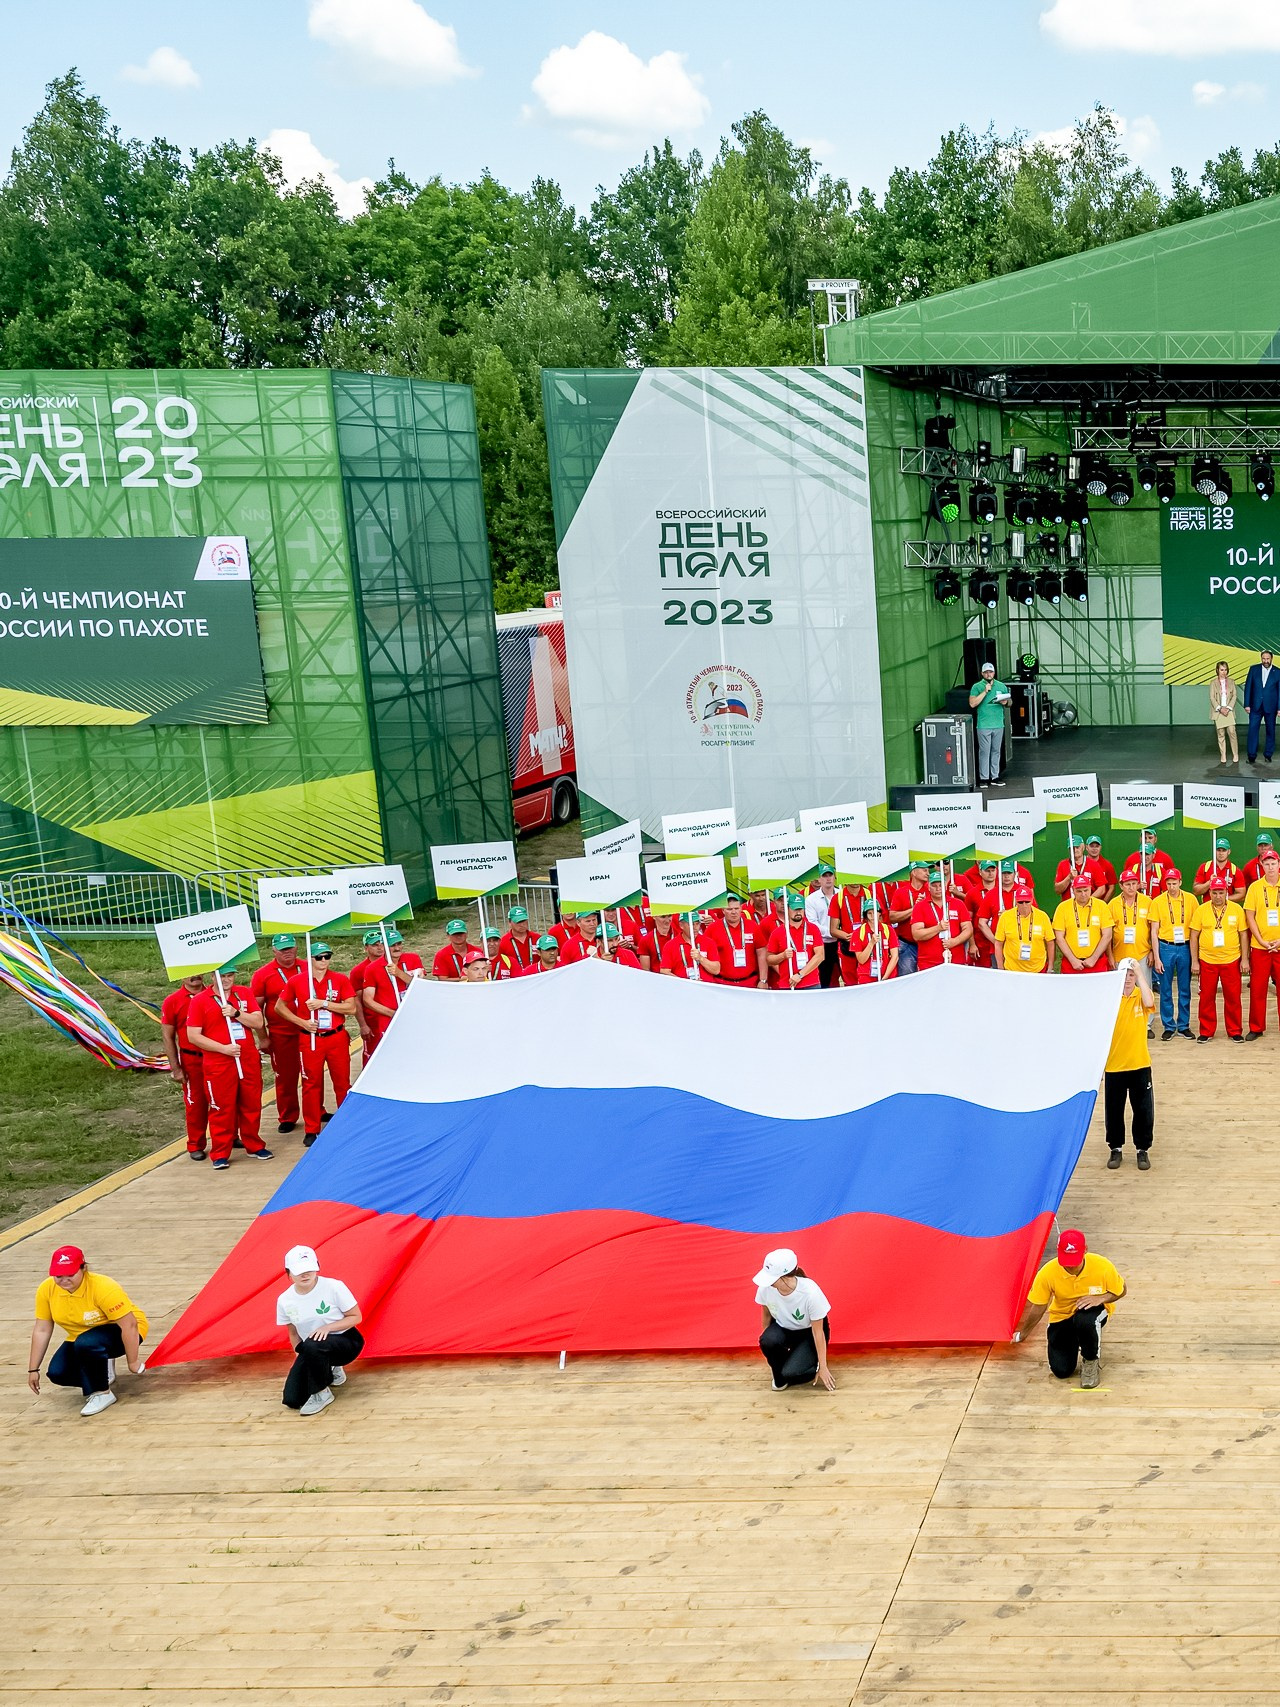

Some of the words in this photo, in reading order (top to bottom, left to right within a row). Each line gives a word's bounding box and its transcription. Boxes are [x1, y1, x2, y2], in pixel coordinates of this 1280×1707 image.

[0, 394, 79, 409] СИЙСКИЙ
[111, 396, 198, 439] 20
[118, 446, 203, 488] 23
[656, 507, 766, 520] ВСЕРОССИЙСКИЙ
[1170, 511, 1206, 520] ДЕНЬ
[1212, 506, 1234, 518] 20
[1170, 521, 1206, 530] ПОЛЯ
[1212, 519, 1234, 530] 23
[658, 521, 769, 549] ДЕНЬ
[1226, 542, 1274, 566] 10-Й
[659, 552, 771, 578] ПОЛЯ
[42, 591, 186, 609] ЧЕМПИОНАТ
[663, 599, 774, 626] 2023
[79, 619, 114, 637] ПО
[119, 618, 209, 637] ПАХОТЕ
[814, 815, 855, 826] КИРОВСКАЯ
[668, 820, 730, 834] КРАСНОДАРСКИЙ
[820, 823, 850, 832] ОБЛАСТЬ
[591, 833, 636, 856] КРАСНОЯРСКИЙ
[846, 844, 897, 852] ПРИМОРСКИЙ
[760, 845, 806, 857] РЕСПУБЛИКА
[440, 856, 508, 865] ЛЕНИНГРАДСКАЯ
[767, 853, 800, 863] КАРЕЛИЯ
[661, 870, 712, 881] РЕСПУБЛИКА
[665, 878, 708, 888] МОРДОВИЯ
[270, 890, 339, 899] ОРЕНБУРГСКАЯ
[178, 924, 233, 940] ОРЛОВСКАЯ
[187, 934, 228, 946] ОБЛАСТЬ
